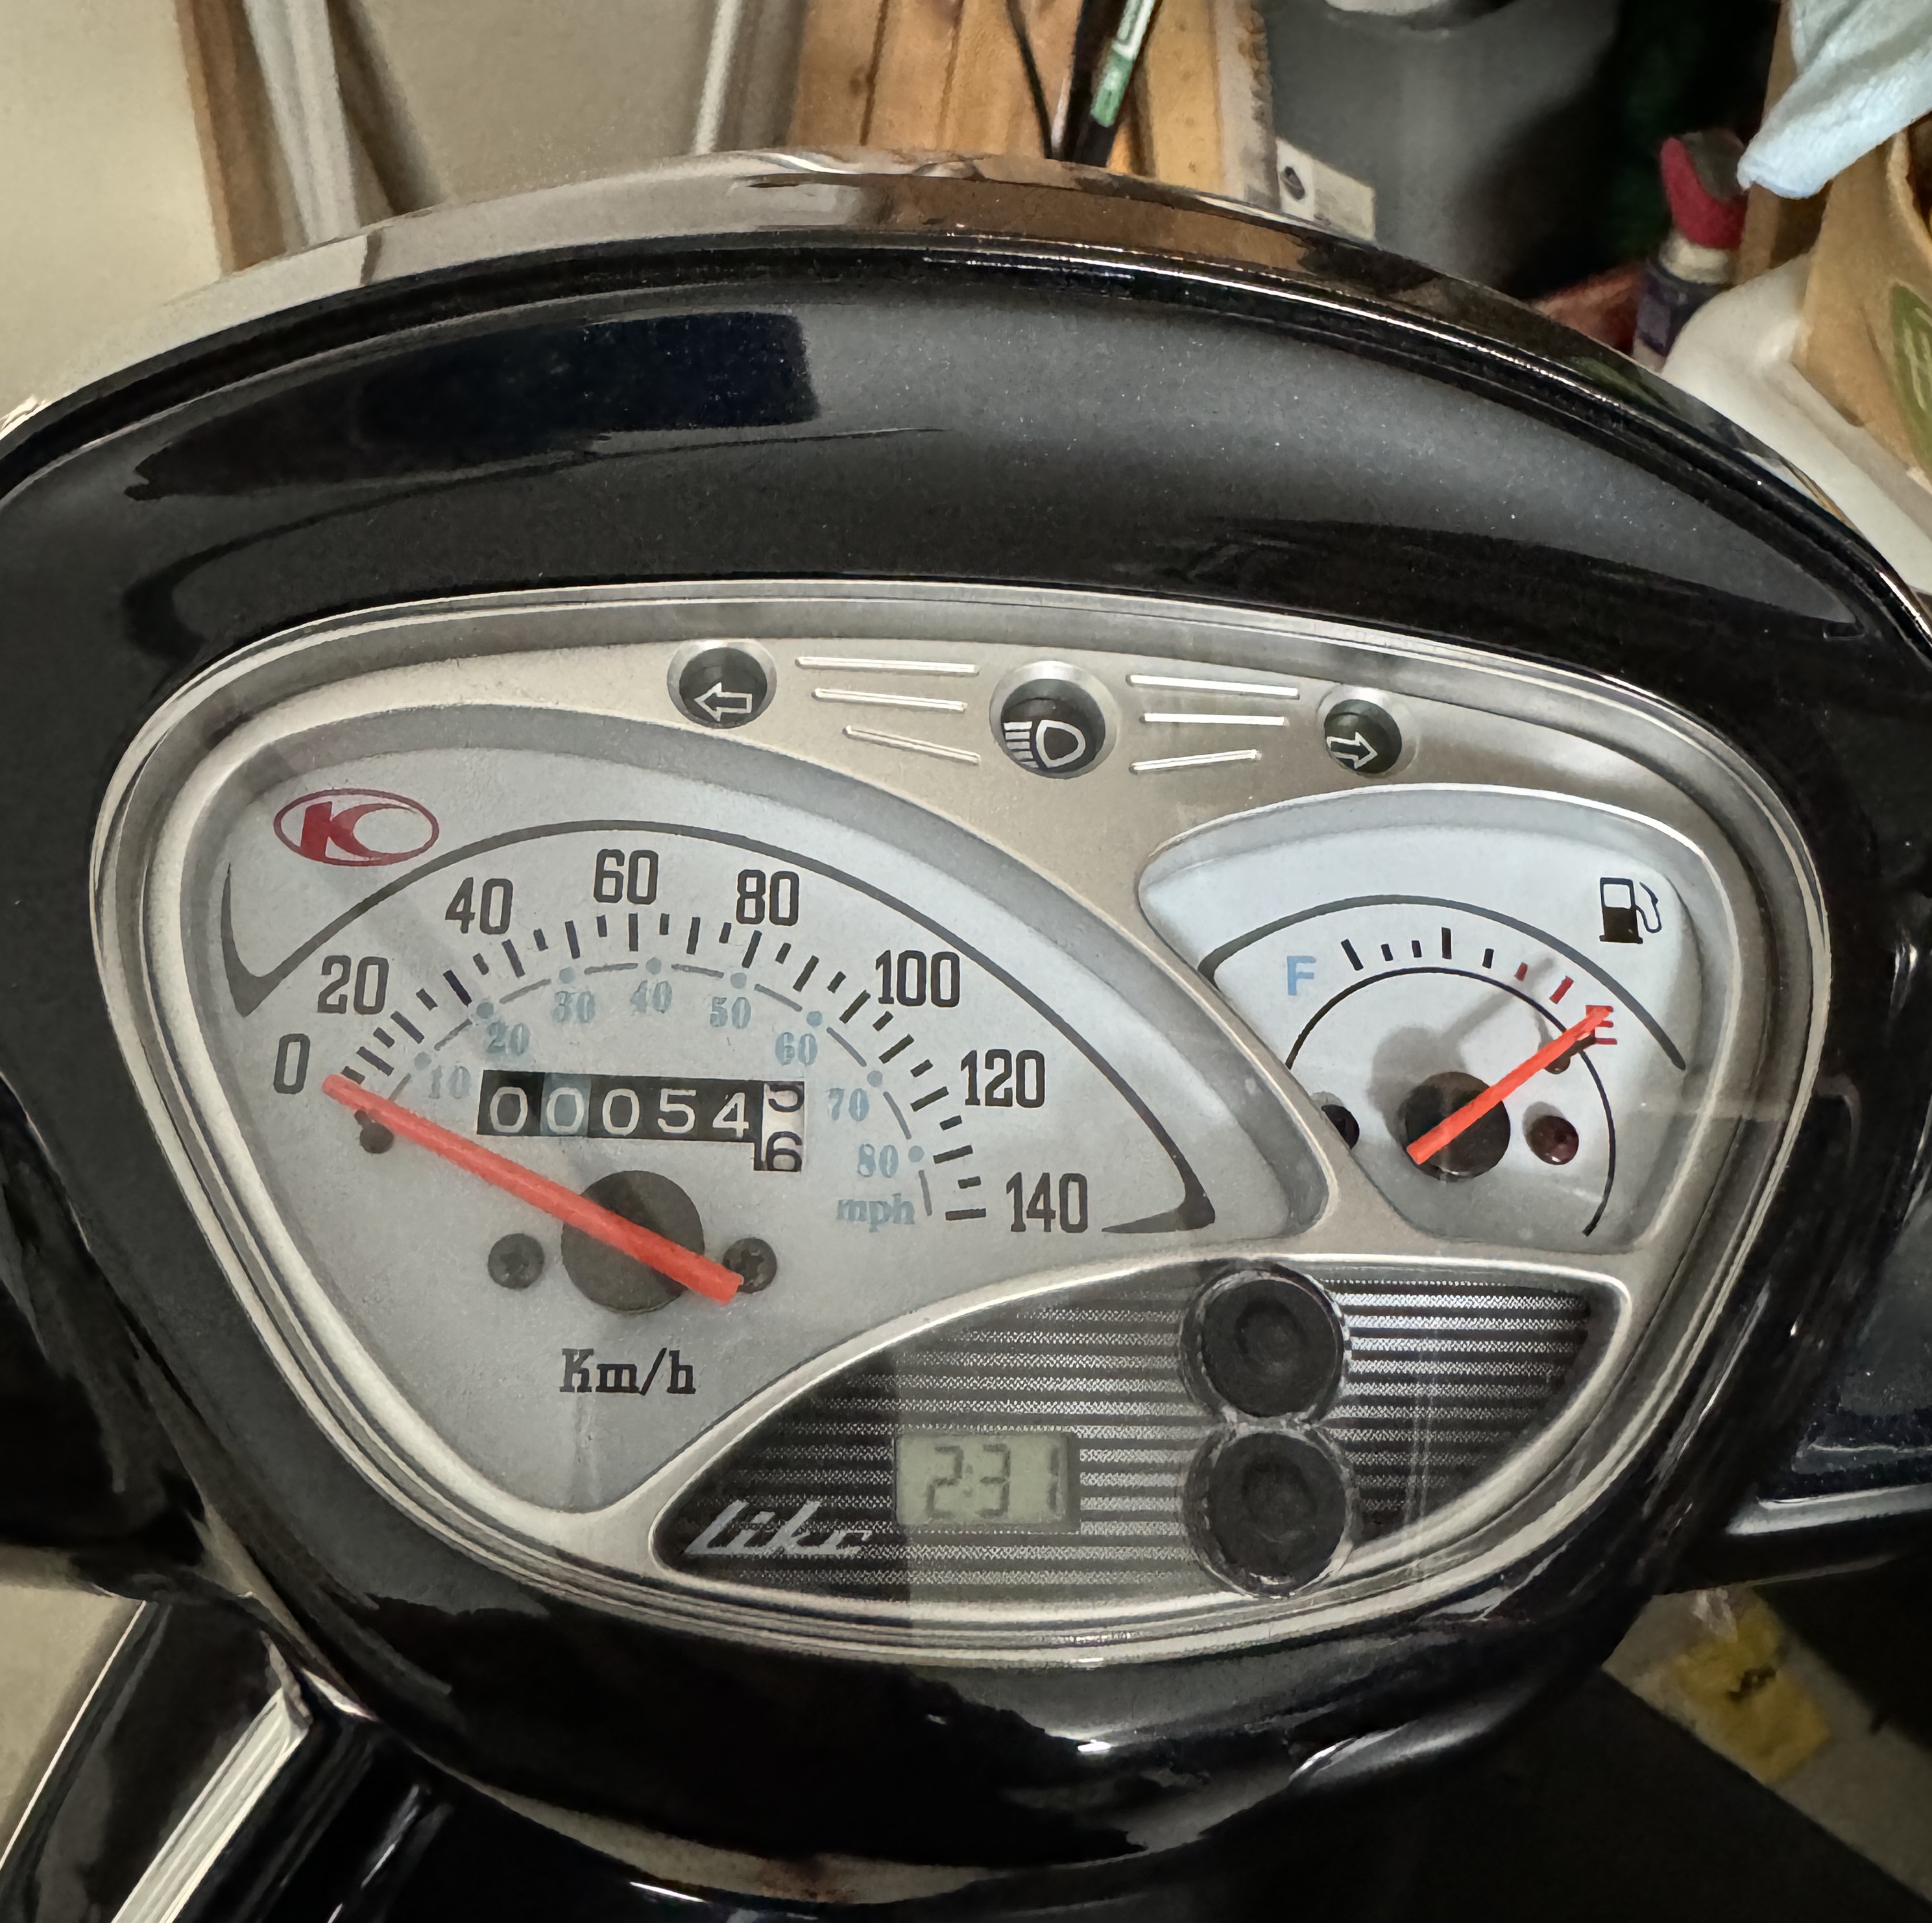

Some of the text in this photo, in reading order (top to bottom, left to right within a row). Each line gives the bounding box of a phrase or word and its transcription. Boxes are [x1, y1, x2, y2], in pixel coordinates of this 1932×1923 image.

[593, 849, 658, 905] 60
[736, 869, 799, 926] 80
[445, 877, 513, 935] 40
[317, 955, 389, 1014] 20
[630, 980, 672, 1013] 40
[875, 949, 960, 1008] 100
[1286, 956, 1316, 996] F
[552, 991, 596, 1023] 30
[710, 997, 751, 1029] 50
[486, 1021, 530, 1056] 20
[775, 1032, 817, 1065] 60
[274, 1034, 310, 1094] 0
[429, 1065, 471, 1099] 10
[960, 1049, 1045, 1108] 120
[827, 1087, 869, 1122] 70
[858, 1143, 900, 1178] 80
[836, 1192, 915, 1233] mph
[1006, 1172, 1088, 1233] 140
[559, 1348, 697, 1395] Km/h
[926, 1443, 1059, 1519] 2:31
